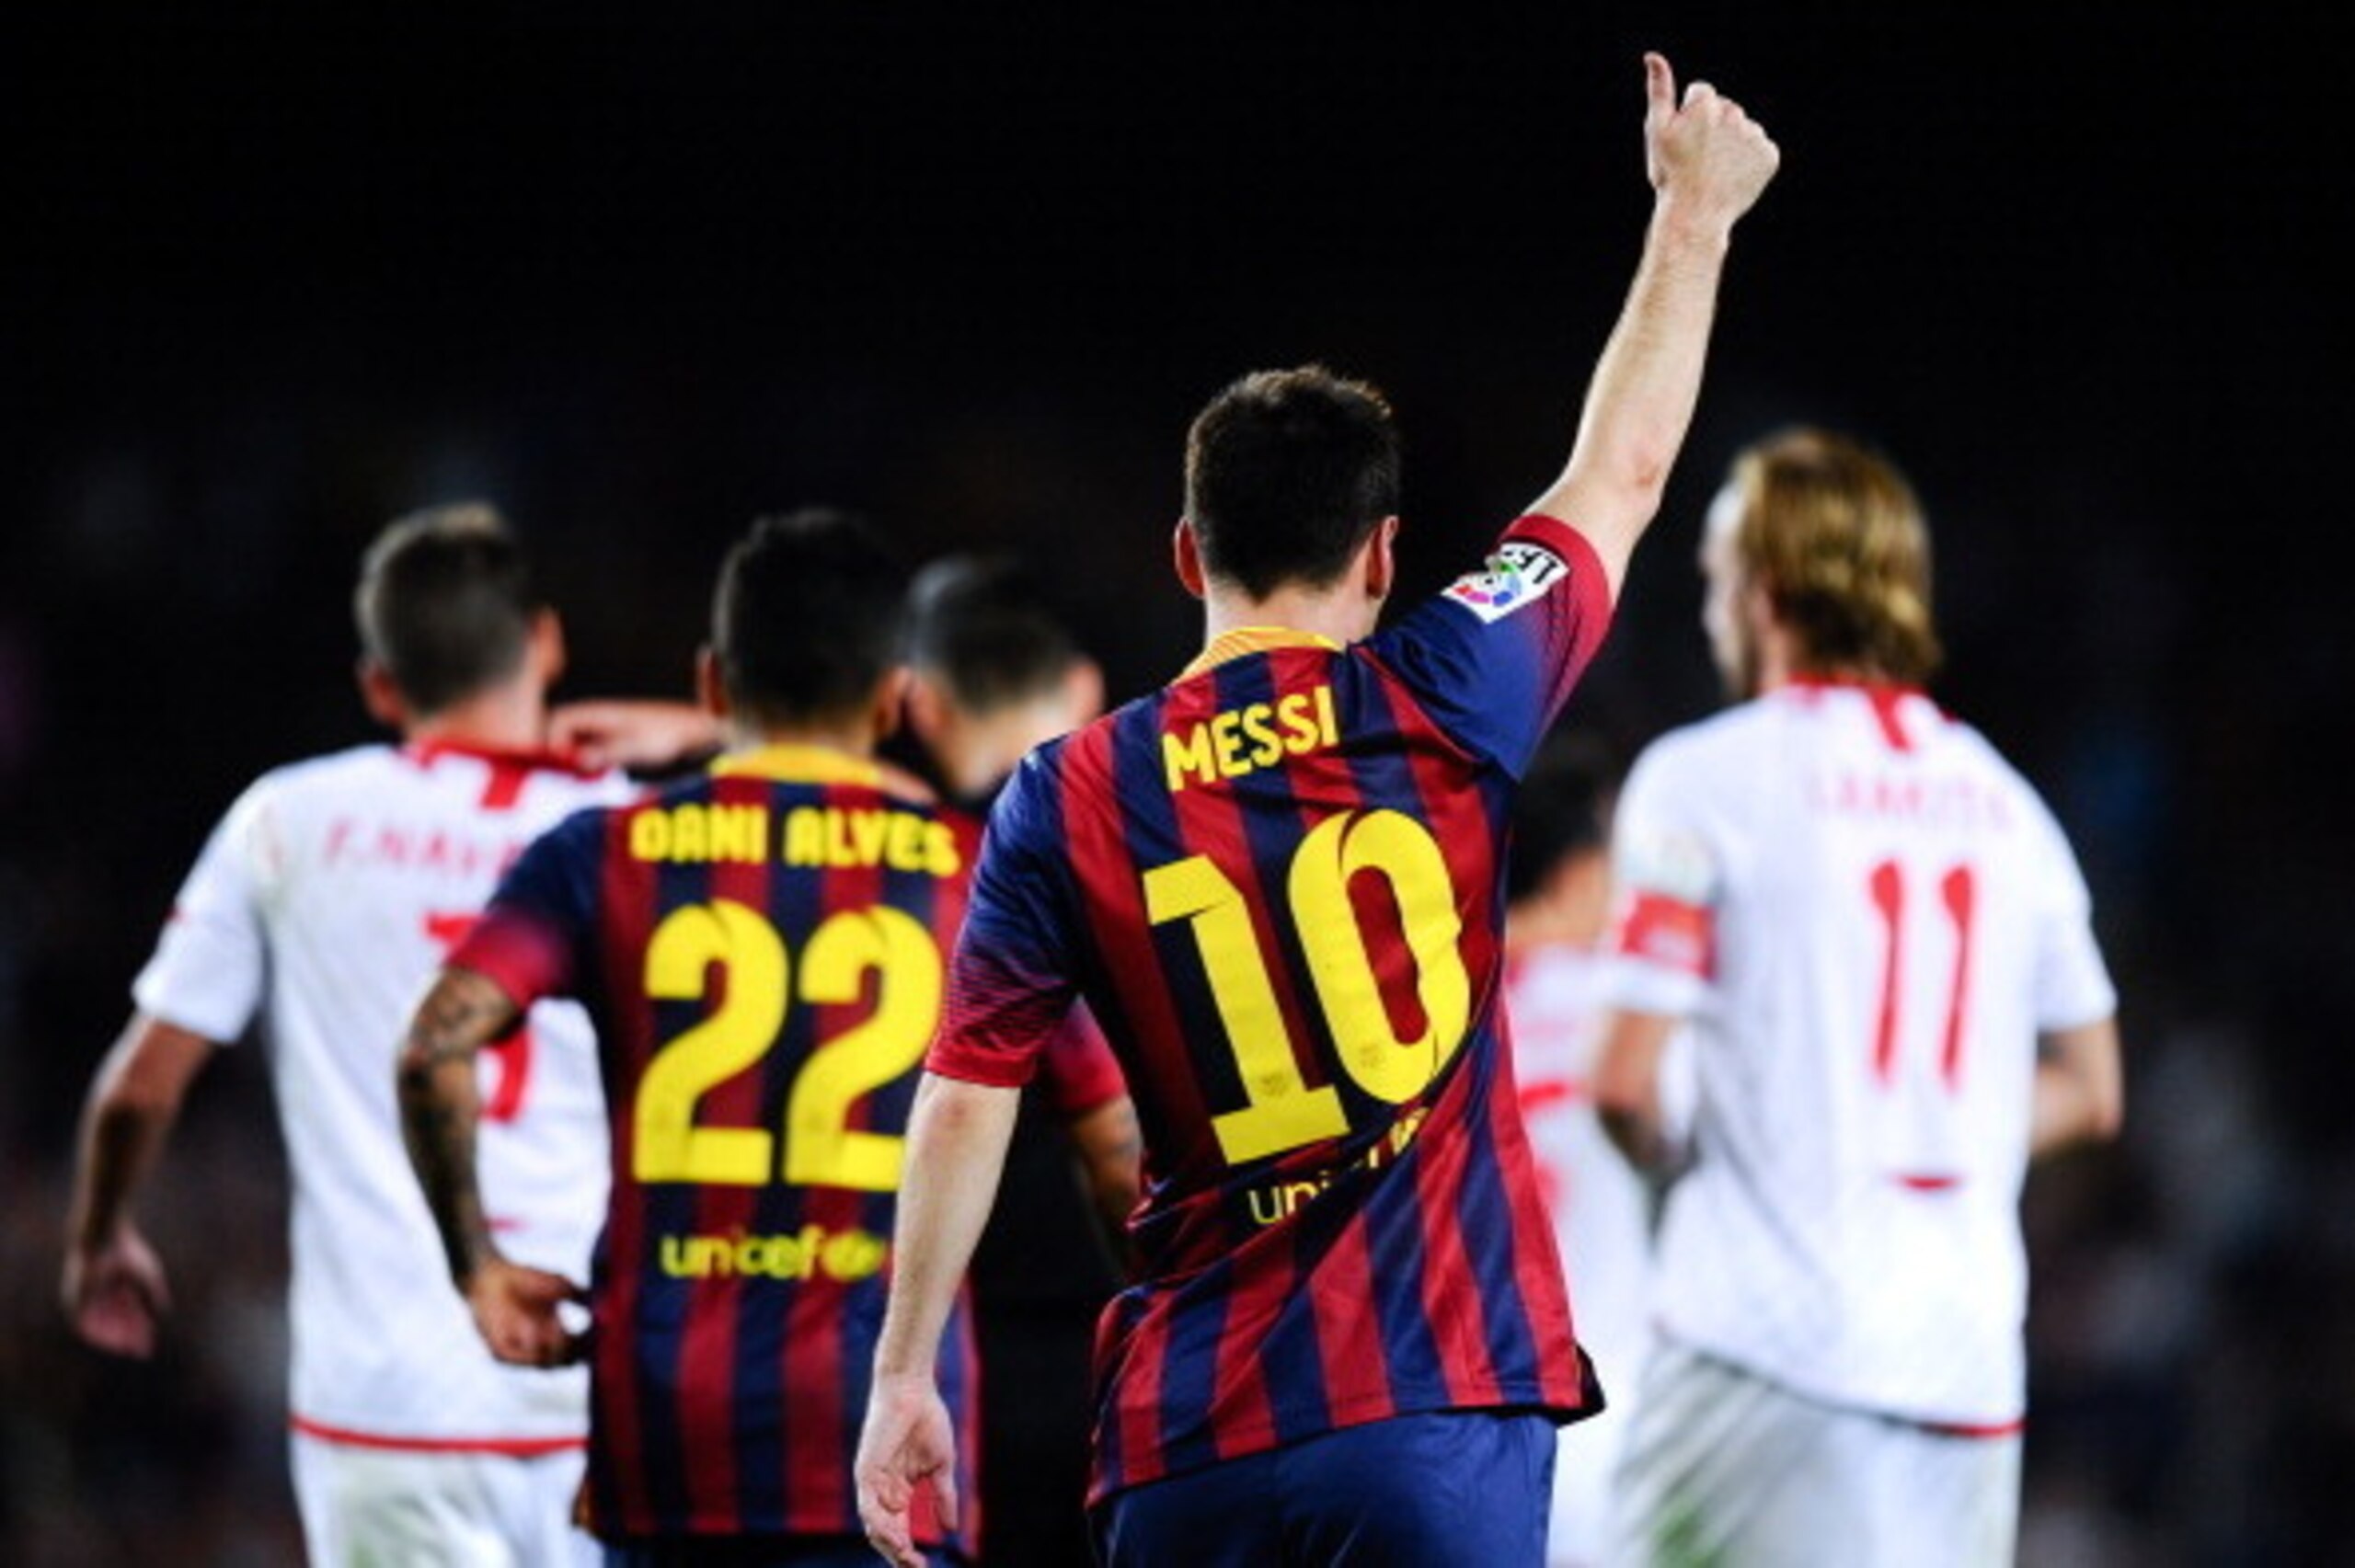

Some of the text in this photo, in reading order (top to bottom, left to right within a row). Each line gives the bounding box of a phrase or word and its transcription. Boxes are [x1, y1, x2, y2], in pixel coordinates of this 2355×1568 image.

[630, 804, 960, 876] DANI ALVES
[1163, 686, 1338, 792] MESSI
[632, 898, 942, 1191] 22
[1143, 809, 1470, 1165] 10
[1869, 859, 1976, 1093] 11
